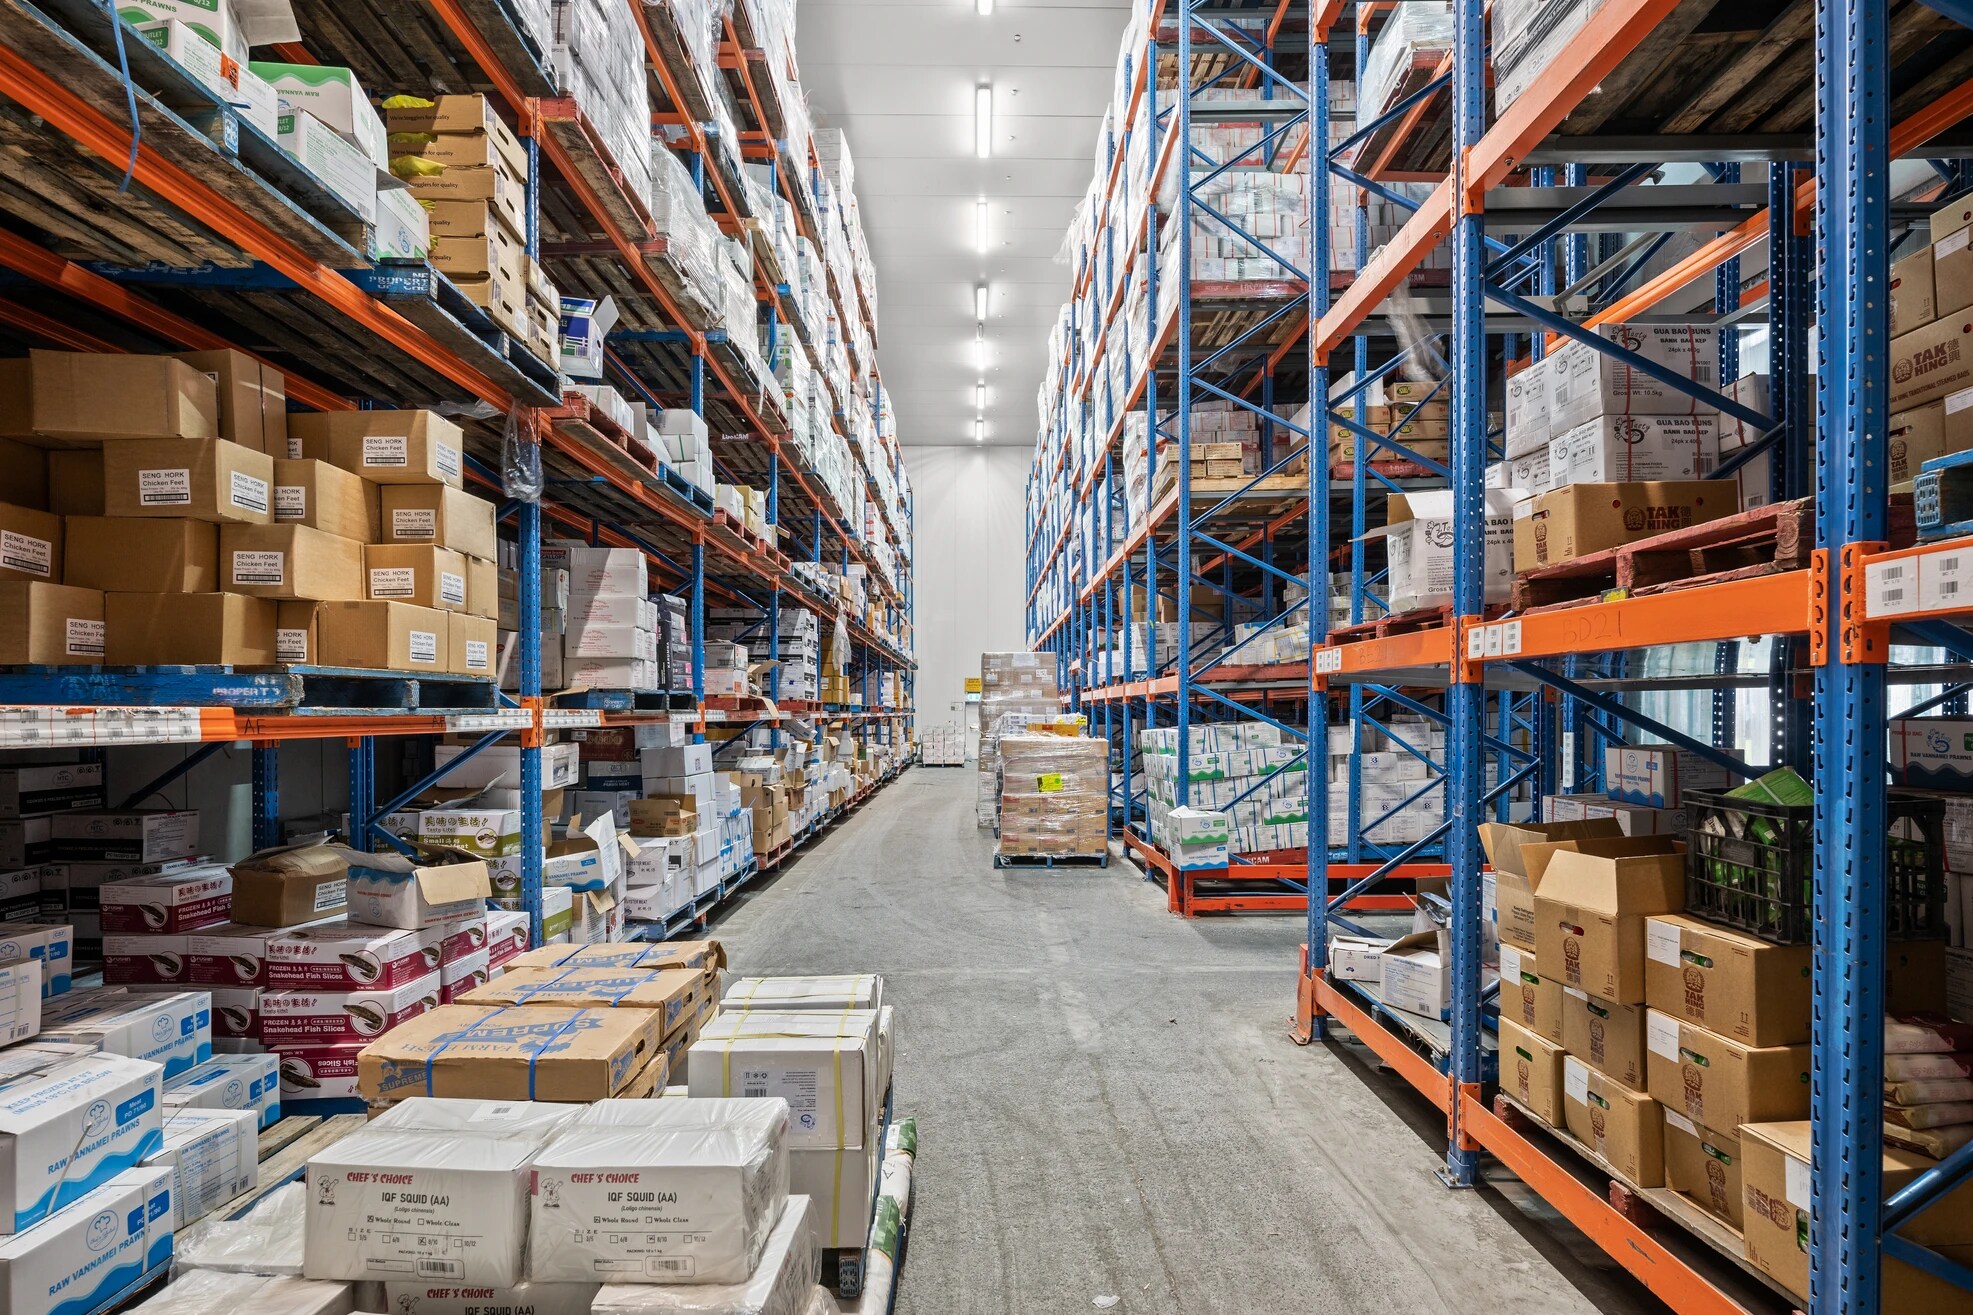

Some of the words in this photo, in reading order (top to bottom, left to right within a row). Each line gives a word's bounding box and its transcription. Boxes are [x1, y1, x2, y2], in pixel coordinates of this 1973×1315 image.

[142, 0, 177, 13] PRAWNS
[432, 114, 450, 122] quality
[436, 150, 454, 158] quality
[434, 254, 452, 262] quality
[1668, 346, 1682, 354] 24pk
[1914, 342, 1947, 364] TAK
[1914, 356, 1948, 377] HING
[1908, 384, 1936, 400] TRADITIONAL
[1936, 376, 1958, 392] STEAMED
[1644, 390, 1663, 398] 10.5kg
[1891, 459, 1908, 468] TAK
[1646, 506, 1680, 520] TAK
[1490, 518, 1509, 526] BAO
[1646, 518, 1680, 530] HING
[4, 534, 24, 544] SENG
[27, 540, 47, 550] HORK
[1536, 540, 1548, 550] TAK
[4, 542, 31, 554] Chicken
[32, 548, 46, 558] Feet
[70, 620, 88, 629] SENG
[70, 629, 94, 637] Chicken
[1922, 752, 1948, 760] VANNAMEI
[570, 870, 588, 878] PRAWNS
[178, 903, 201, 914] FROZEN
[178, 907, 212, 922] Snakehead
[212, 904, 226, 913] Fish
[1564, 958, 1580, 970] TAK
[268, 972, 305, 980] Snakehead
[305, 972, 321, 980] Fish
[322, 972, 343, 980] Slices
[1684, 988, 1705, 1003] TAK
[1684, 998, 1705, 1010] HING
[263, 1026, 303, 1034] Snakehead
[143, 1041, 174, 1060] VANNAMEI
[466, 1043, 512, 1052] FARM
[79, 1068, 114, 1088] BELOW
[144, 1074, 156, 1086] CS7
[382, 1070, 428, 1092] SUPREME
[33, 1080, 67, 1100] FROZEN
[1684, 1086, 1703, 1102] TAK
[128, 1098, 142, 1109] Meat
[192, 1138, 212, 1152] VANNAMEI
[212, 1128, 230, 1142] PRAWNS
[48, 1158, 68, 1175] RAW
[110, 1118, 140, 1140] PRAWNS
[154, 1176, 166, 1188] CS7
[346, 1172, 379, 1184] CHEF'S
[379, 1174, 414, 1185] CHOICE
[570, 1172, 603, 1184] CHEF'S
[606, 1172, 640, 1184] CHOICE
[381, 1192, 398, 1204] IQF
[400, 1193, 428, 1205] SQUID
[430, 1194, 450, 1207] (AA)
[607, 1192, 623, 1203] IQF
[626, 1192, 655, 1203] SQUID
[657, 1192, 678, 1204] (AA)
[394, 1206, 411, 1214] (Loligo
[620, 1204, 638, 1212] (Loligo
[638, 1205, 663, 1213] chinensis)
[374, 1216, 392, 1224] Whole
[394, 1217, 411, 1225] Round
[444, 1220, 460, 1228] Clean
[602, 1216, 619, 1224] Whole
[620, 1216, 639, 1224] Round
[654, 1216, 671, 1224] Whole
[672, 1216, 689, 1224] Clean
[428, 1238, 438, 1246] 8/10
[656, 1235, 668, 1243] 8/10
[48, 1275, 70, 1297] RAW
[72, 1248, 118, 1280] VANNAMEI
[426, 1288, 460, 1299] CHEF'S
[460, 1288, 495, 1299] CHOICE
[464, 1306, 480, 1315] IQF
[483, 1306, 512, 1315] SQUID
[514, 1305, 535, 1315] (AA)
